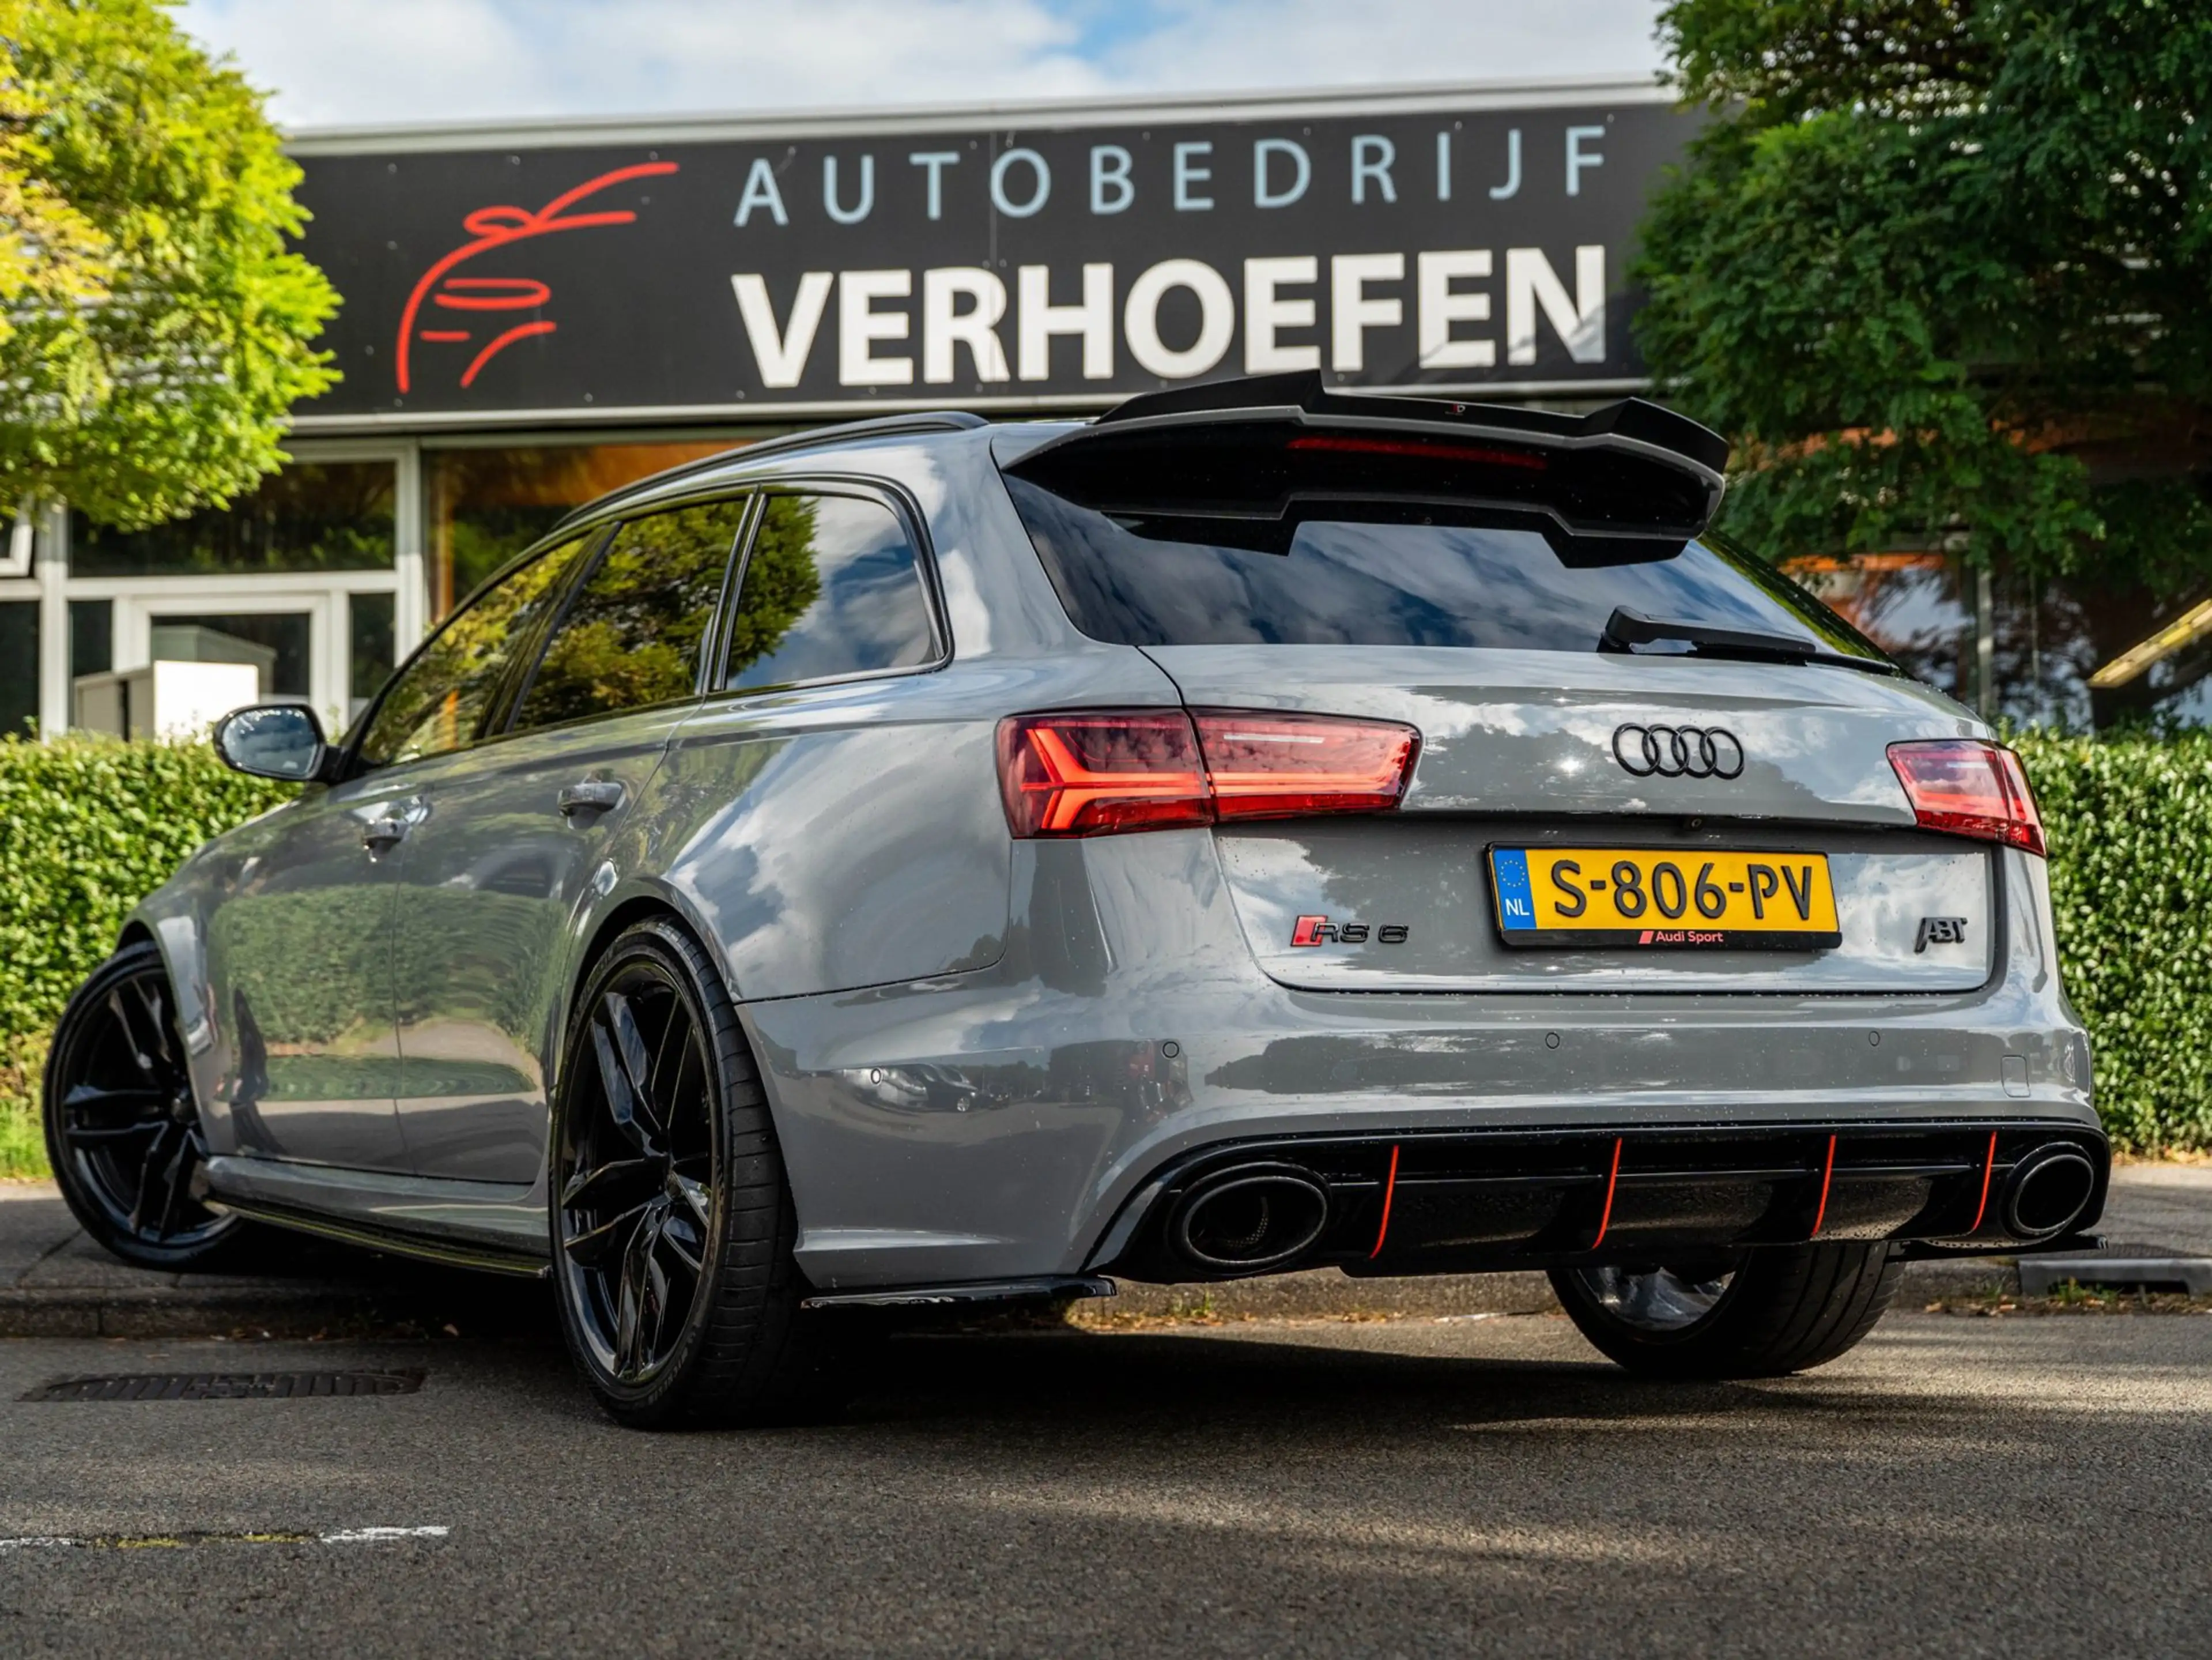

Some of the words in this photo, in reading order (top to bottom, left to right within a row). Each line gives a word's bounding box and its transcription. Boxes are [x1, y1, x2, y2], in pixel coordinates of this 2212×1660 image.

[734, 125, 1606, 227] AUTOBEDRIJF
[731, 244, 1607, 388] VERHOEFEN
[1505, 898, 1530, 916] NL
[1551, 859, 1812, 920] S-806-PV
[1378, 923, 1409, 944] 6
[1655, 930, 1685, 942] Audi
[1688, 931, 1724, 944] Sport
[1913, 917, 1968, 954] ABT
